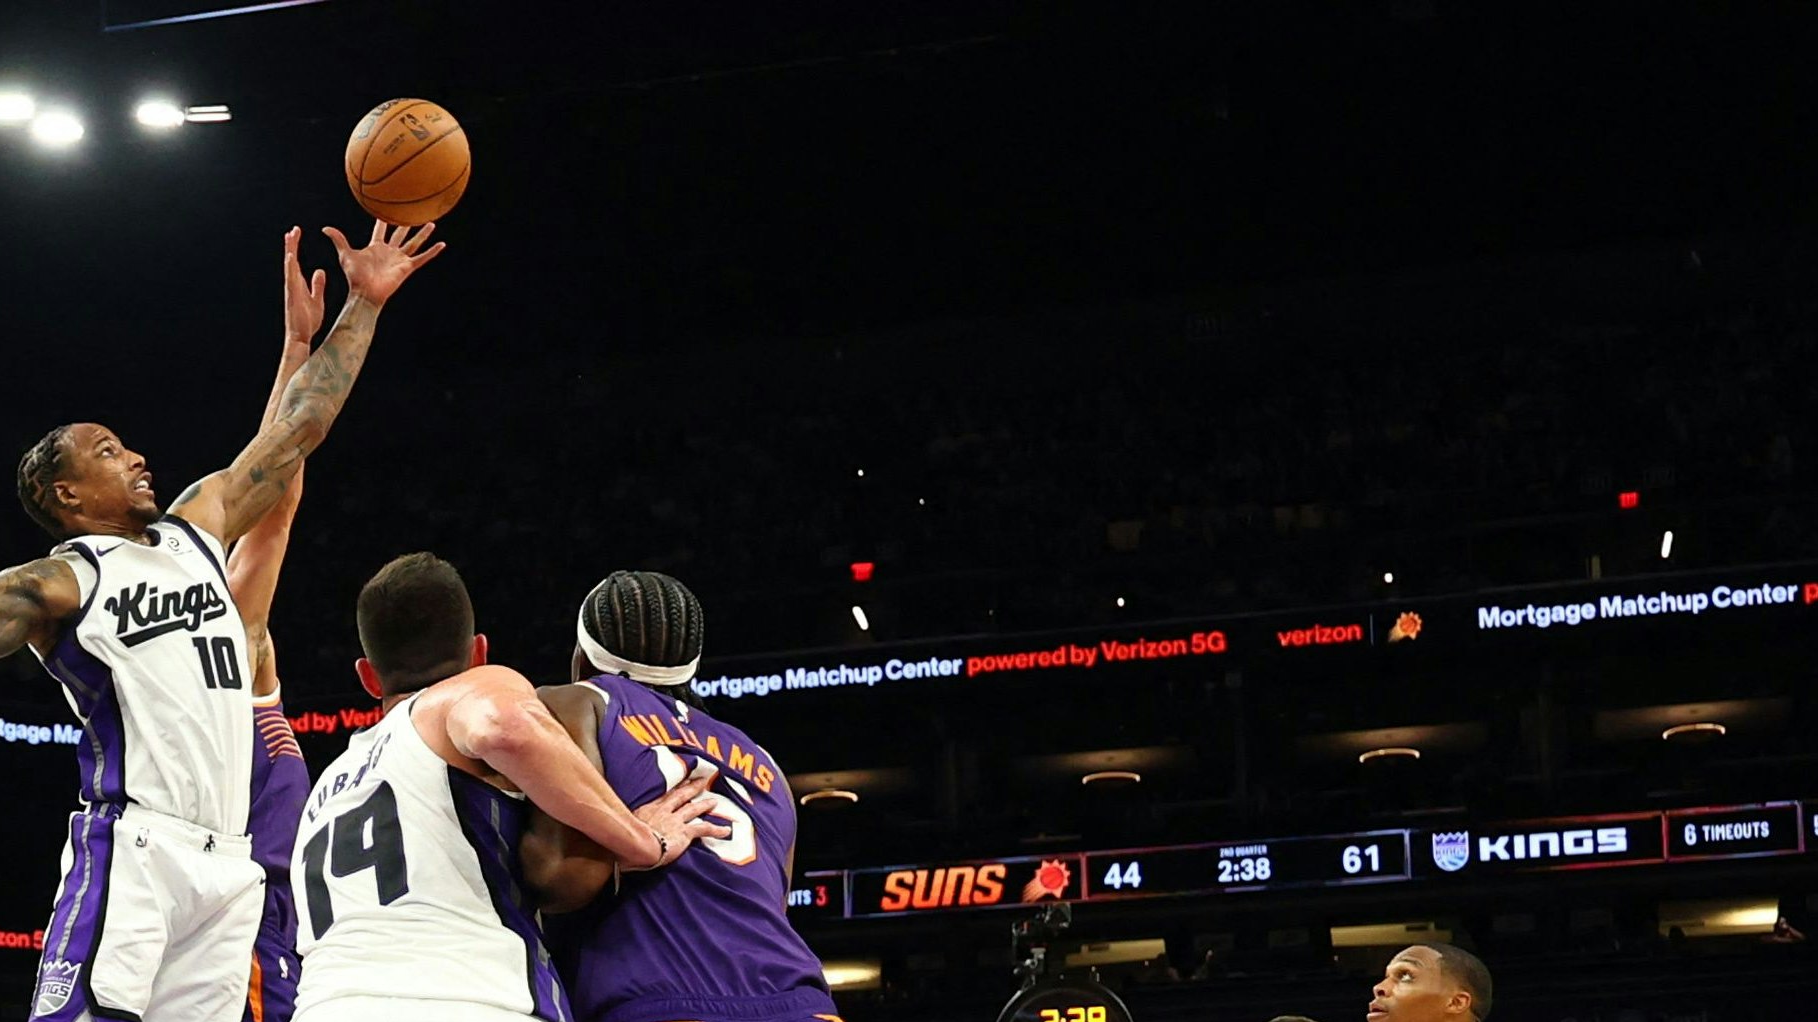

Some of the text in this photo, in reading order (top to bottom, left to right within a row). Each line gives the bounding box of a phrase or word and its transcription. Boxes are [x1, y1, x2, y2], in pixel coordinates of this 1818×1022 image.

[103, 581, 227, 640] Kings
[1478, 602, 1596, 629] Mortgage
[1599, 591, 1709, 619] Matchup
[1711, 583, 1799, 608] Center
[1277, 624, 1362, 647] verizon
[192, 636, 242, 690] 10
[691, 631, 1226, 699] ortgage Matchup Center powered by Verizon 5G
[340, 706, 383, 728] Veri
[1478, 827, 1627, 862] KINGS
[1684, 821, 1770, 846] 6 TIMEOUTS
[1217, 857, 1272, 882] 2:38
[1342, 845, 1380, 874] 61
[881, 864, 1006, 911] SUNS
[1103, 861, 1142, 890] 44
[815, 885, 828, 906] 3
[29, 930, 43, 949] 5
